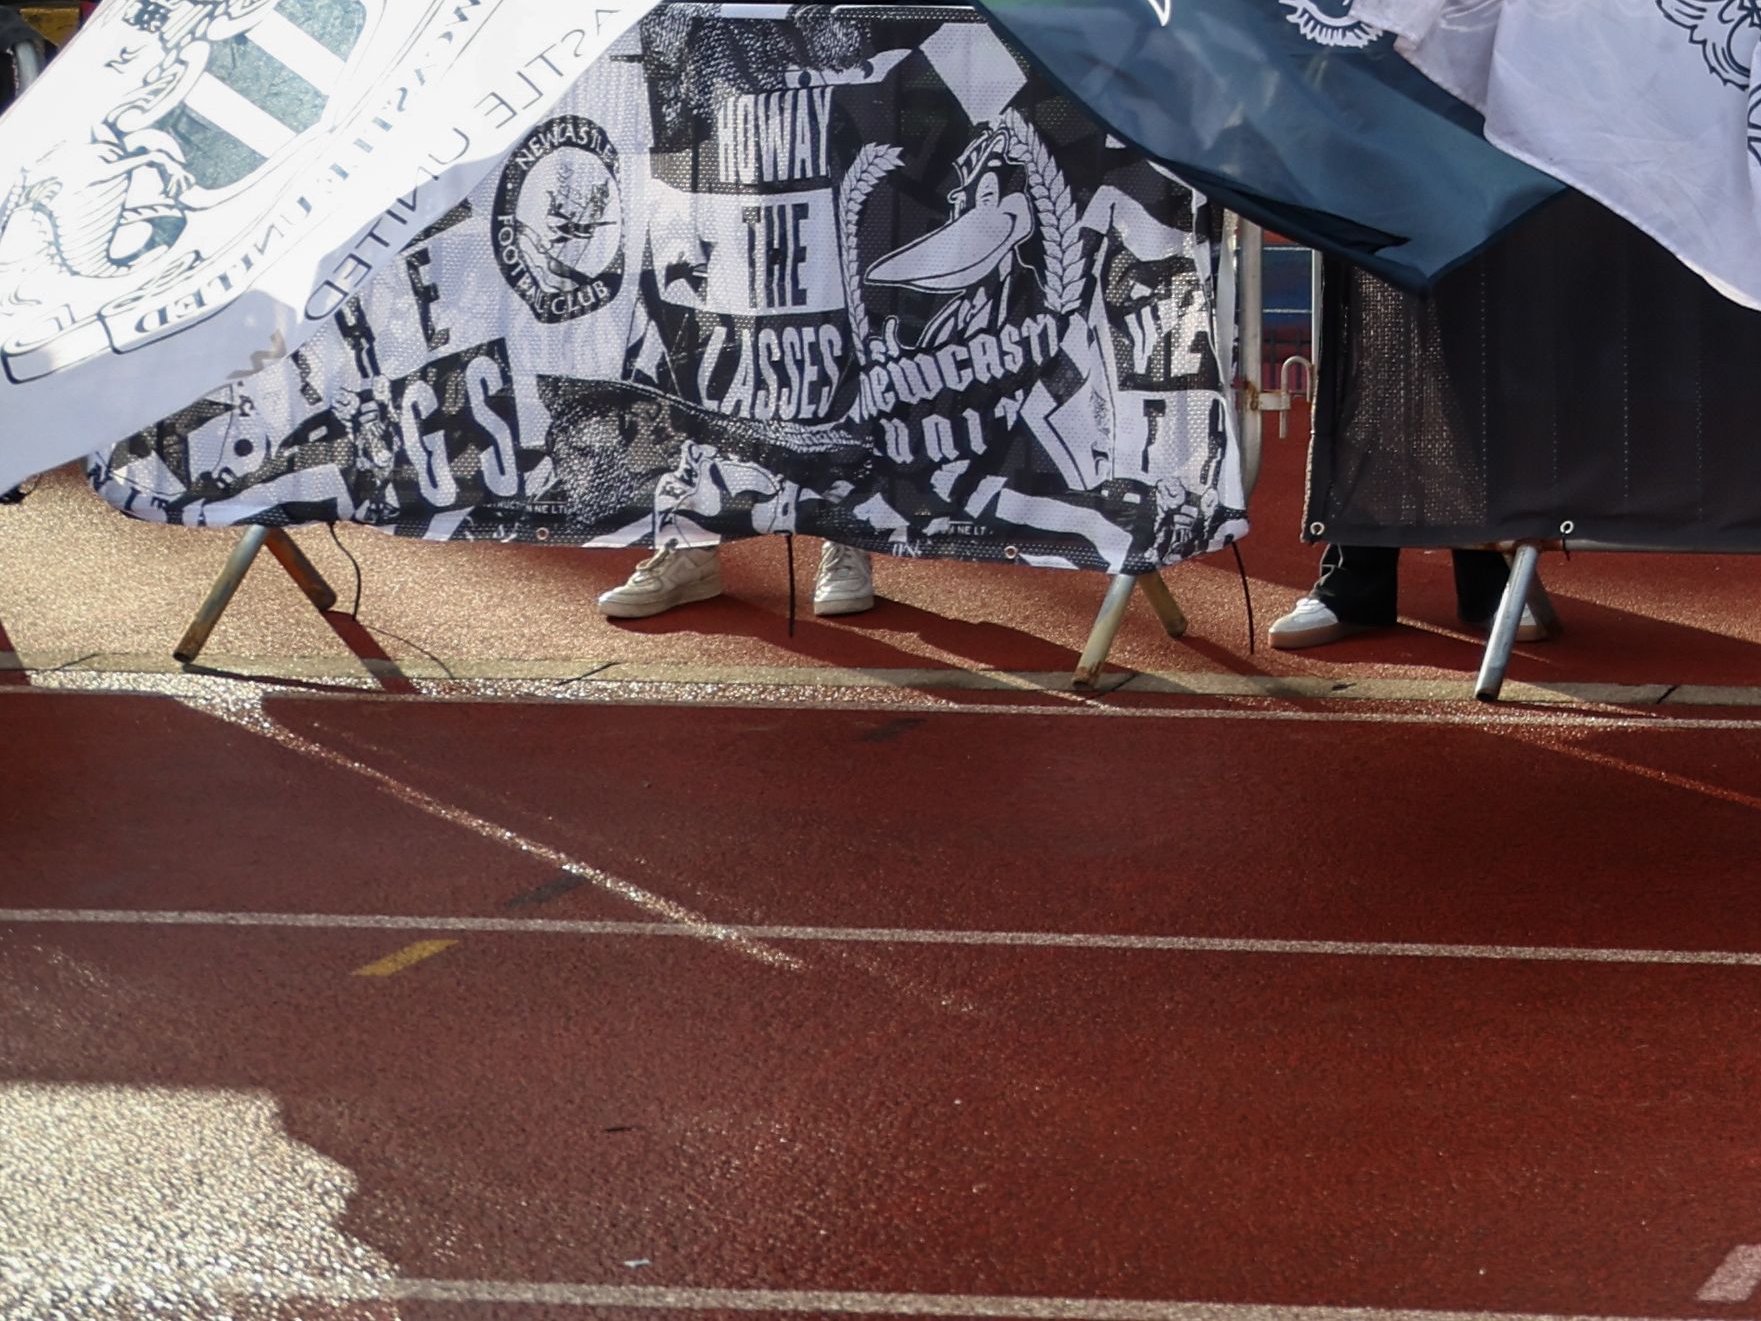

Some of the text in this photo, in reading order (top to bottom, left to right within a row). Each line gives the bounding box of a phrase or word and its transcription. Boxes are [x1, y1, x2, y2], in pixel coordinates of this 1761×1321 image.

[718, 86, 834, 184] HOWAY
[551, 279, 609, 315] CLUB
[741, 202, 809, 309] THE
[696, 322, 843, 421] LASSES
